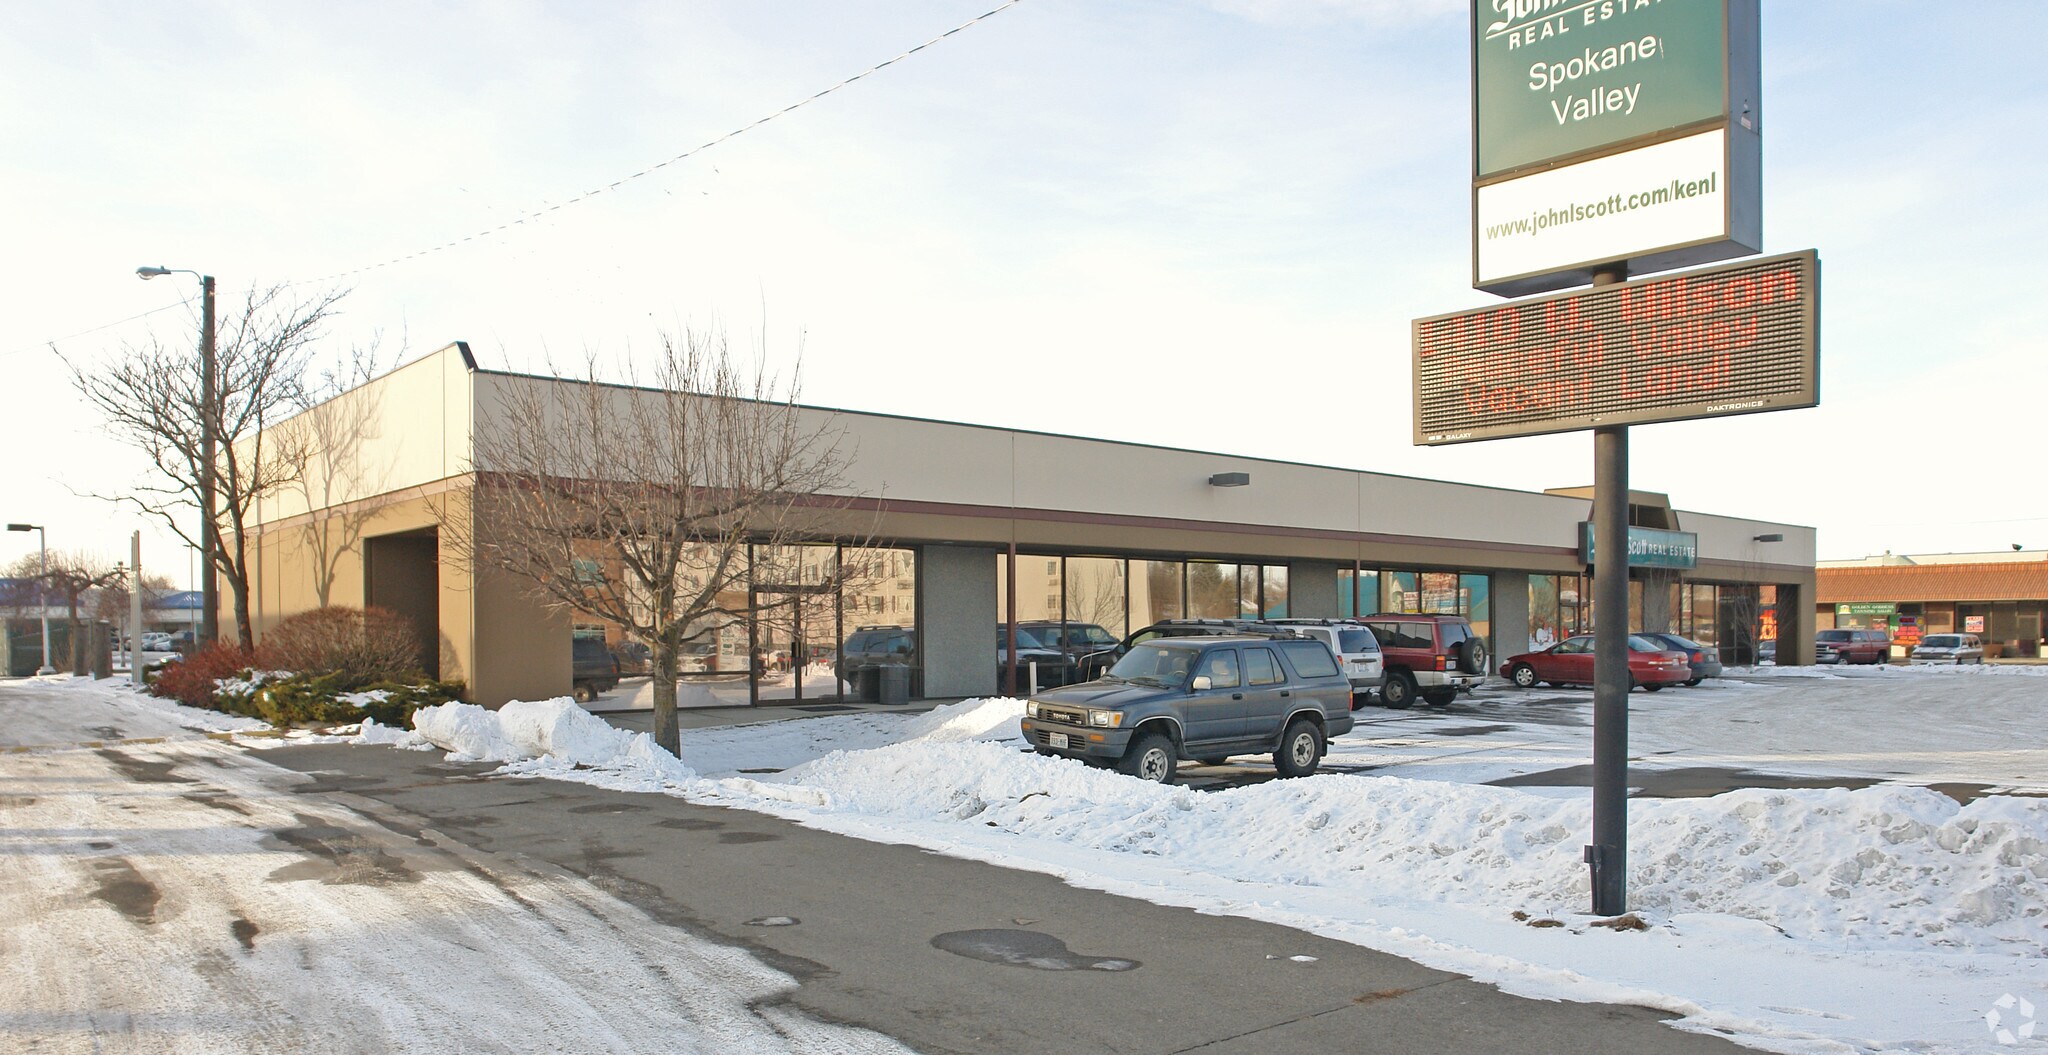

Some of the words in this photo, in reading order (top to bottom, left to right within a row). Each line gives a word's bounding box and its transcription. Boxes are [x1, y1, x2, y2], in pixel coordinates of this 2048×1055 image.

[1509, 17, 1569, 50] REAL
[1529, 35, 1656, 92] Spokane
[1551, 83, 1641, 125] Valley
[1486, 171, 1716, 240] www.johnlscott.com/kenl
[1621, 271, 1797, 325] Wilson
[1631, 315, 1757, 360] Valley
[1463, 372, 1593, 416] Vacant
[1706, 400, 1764, 413] DAKTRONICS
[1648, 543, 1667, 556] REAL
[1669, 545, 1695, 558] ESTATE
[1053, 713, 1071, 721] TOYOTA
